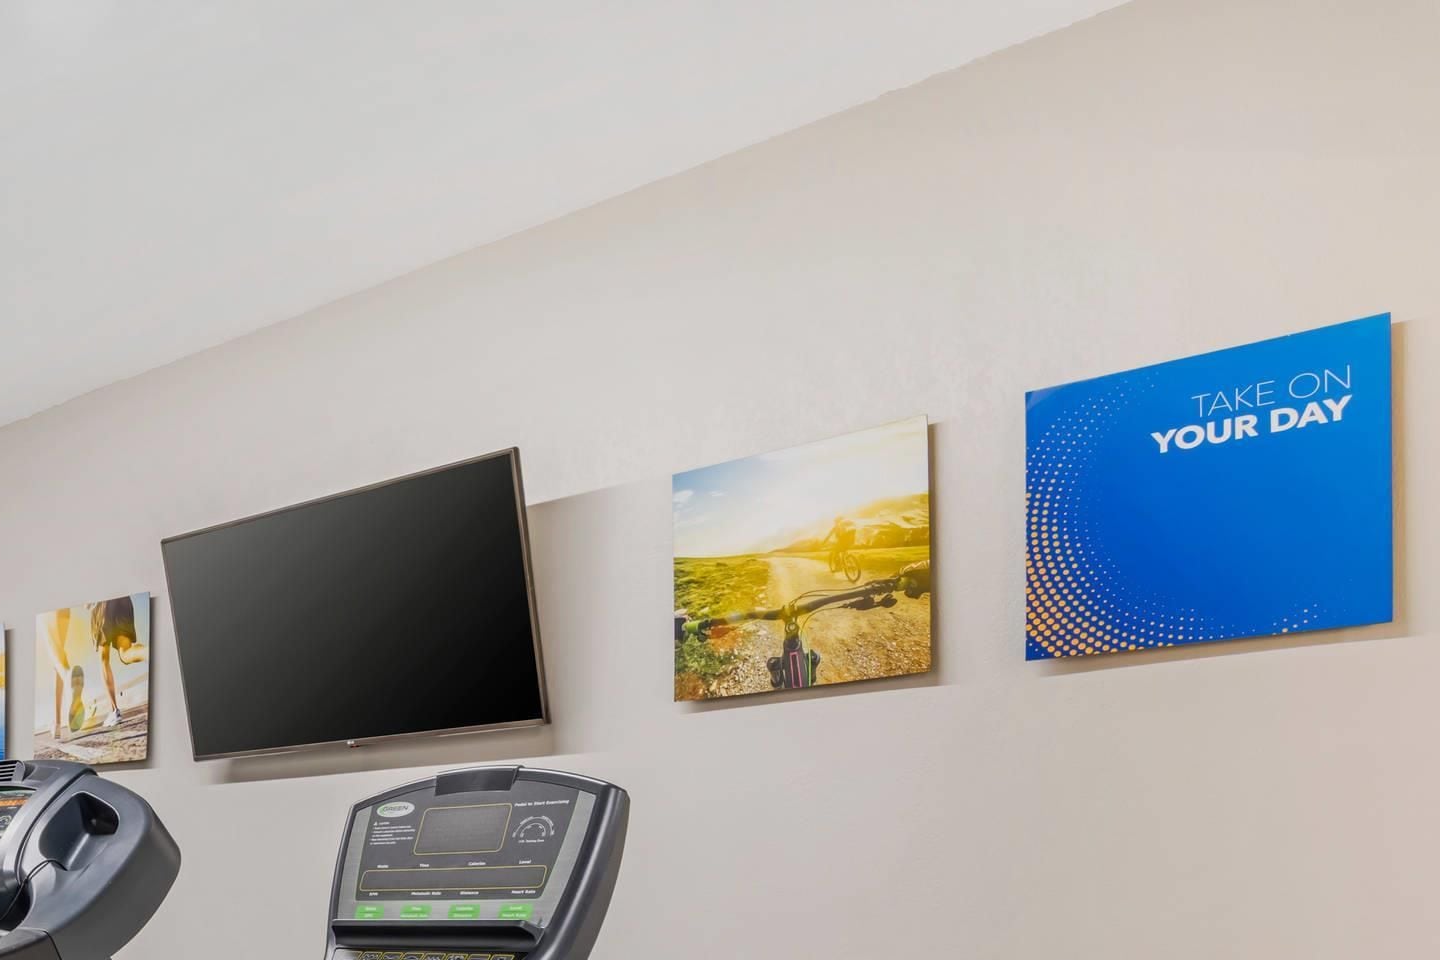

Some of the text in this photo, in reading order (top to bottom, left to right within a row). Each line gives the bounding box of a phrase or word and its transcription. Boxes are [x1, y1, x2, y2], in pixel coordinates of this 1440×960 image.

[1191, 364, 1351, 418] TAKE ON
[1150, 394, 1353, 454] YOUR DAY
